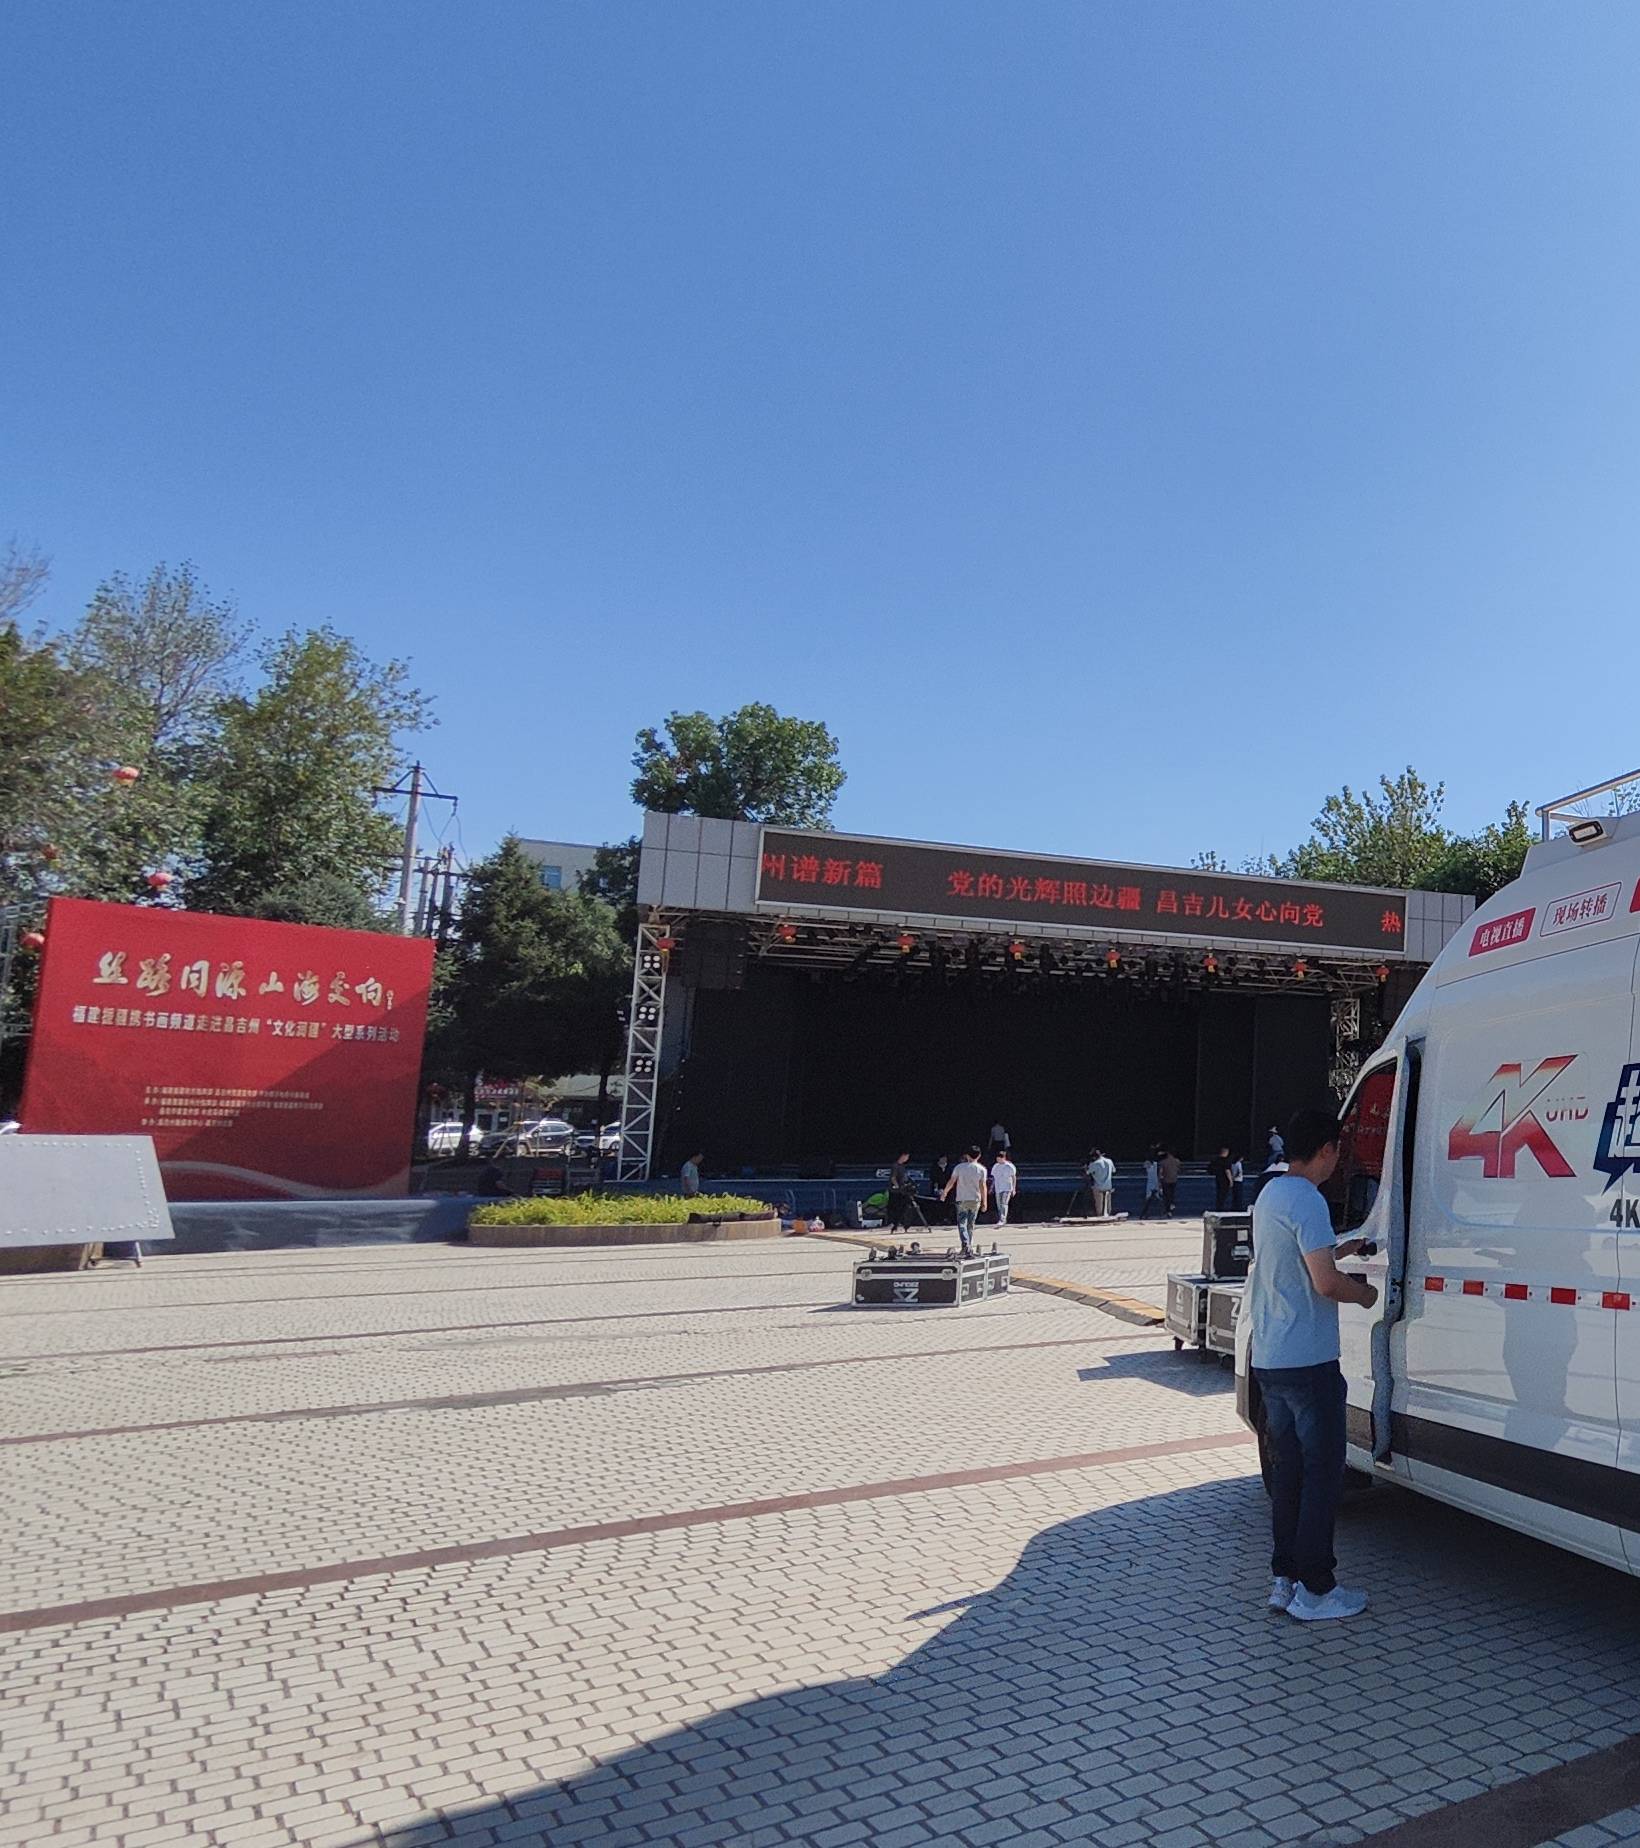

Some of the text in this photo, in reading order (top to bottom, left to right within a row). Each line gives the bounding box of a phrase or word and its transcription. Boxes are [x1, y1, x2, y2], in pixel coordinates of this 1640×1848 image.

[762, 853, 884, 889] 州谱新篇
[947, 869, 1142, 911] 党的光辉照边疆
[1156, 889, 1324, 928] 昌吉儿女心向党
[1553, 893, 1608, 926] 现场转播
[1480, 916, 1525, 947] 电视直播
[1447, 1053, 1578, 1179] 4K
[1609, 1199, 1640, 1229] 4K
